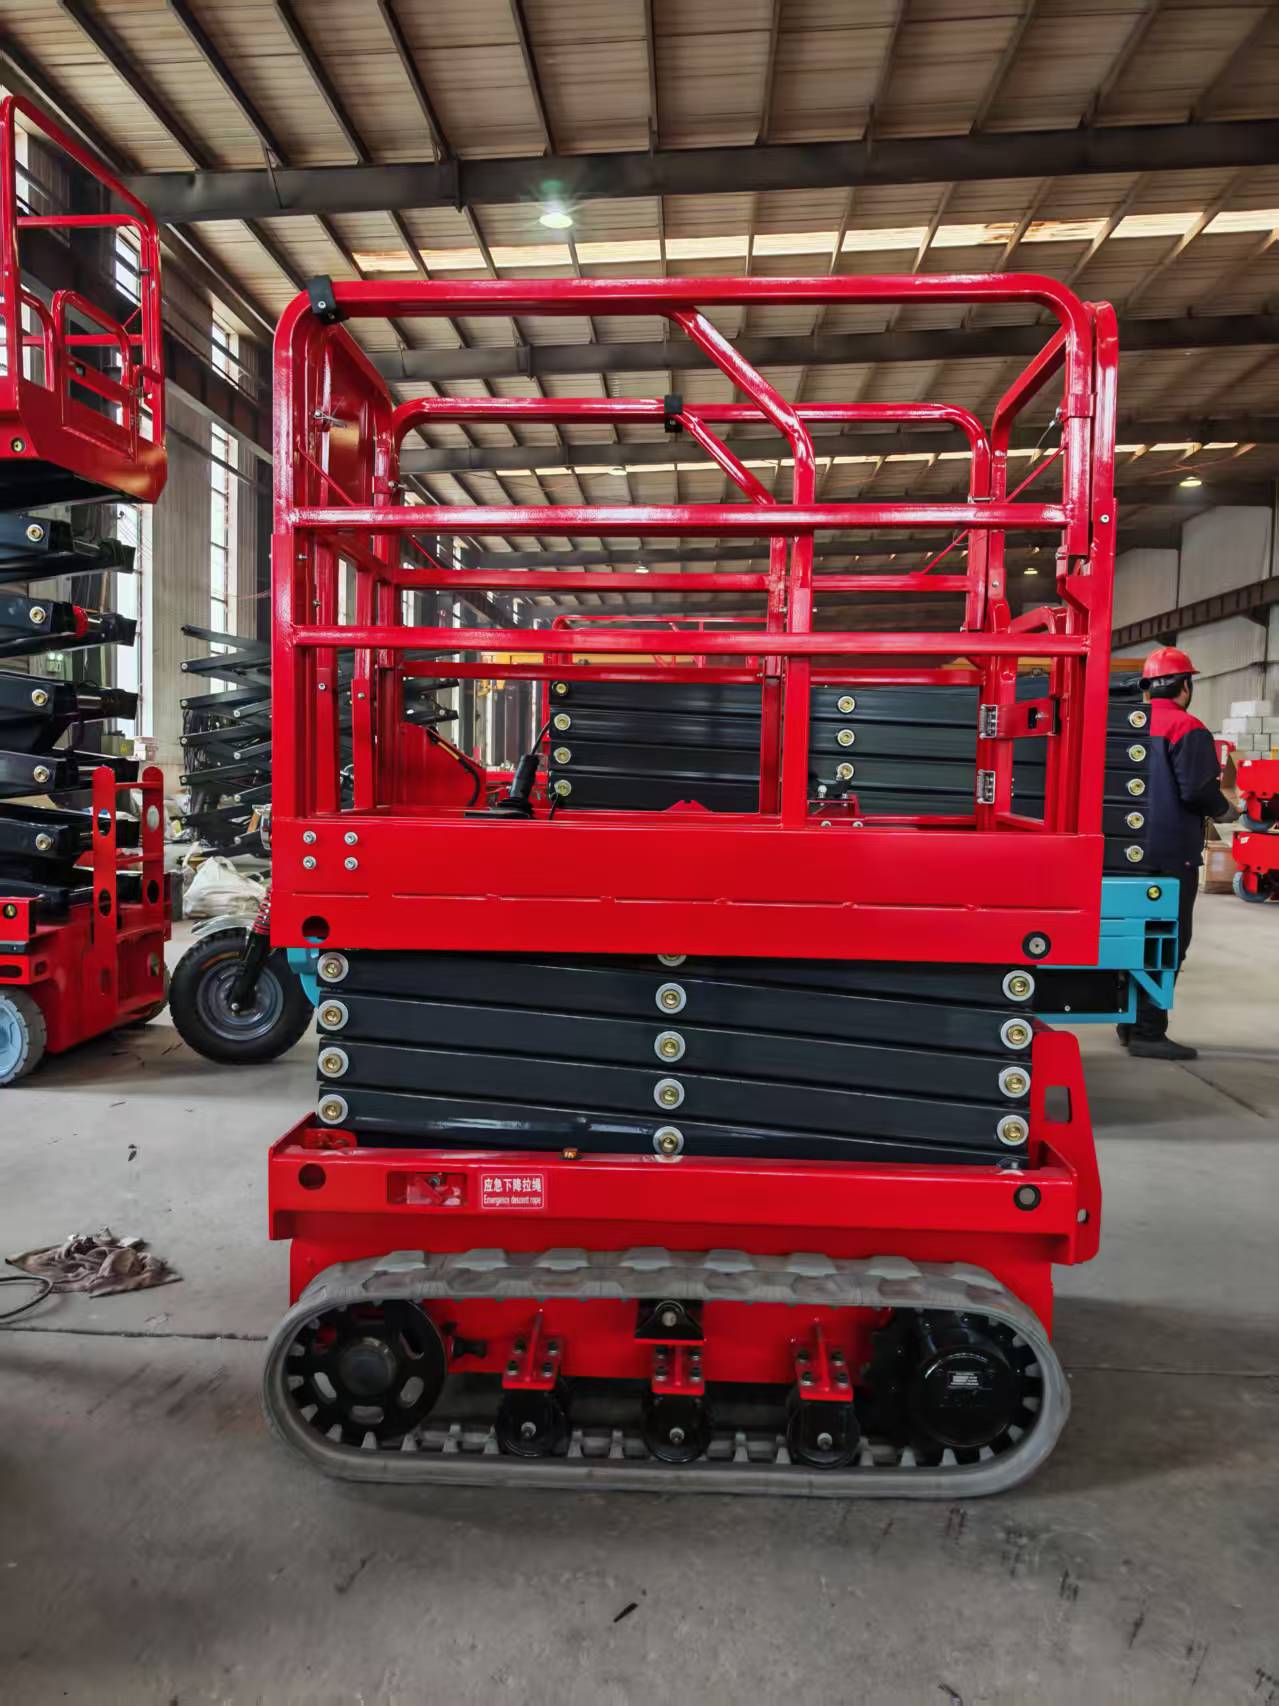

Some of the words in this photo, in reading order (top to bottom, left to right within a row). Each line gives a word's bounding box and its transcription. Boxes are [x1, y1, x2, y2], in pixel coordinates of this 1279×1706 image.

[484, 1177, 542, 1192] 应急下降拉绳
[484, 1194, 510, 1206] Emergency
[511, 1195, 530, 1204] descent
[531, 1197, 541, 1206] rope
